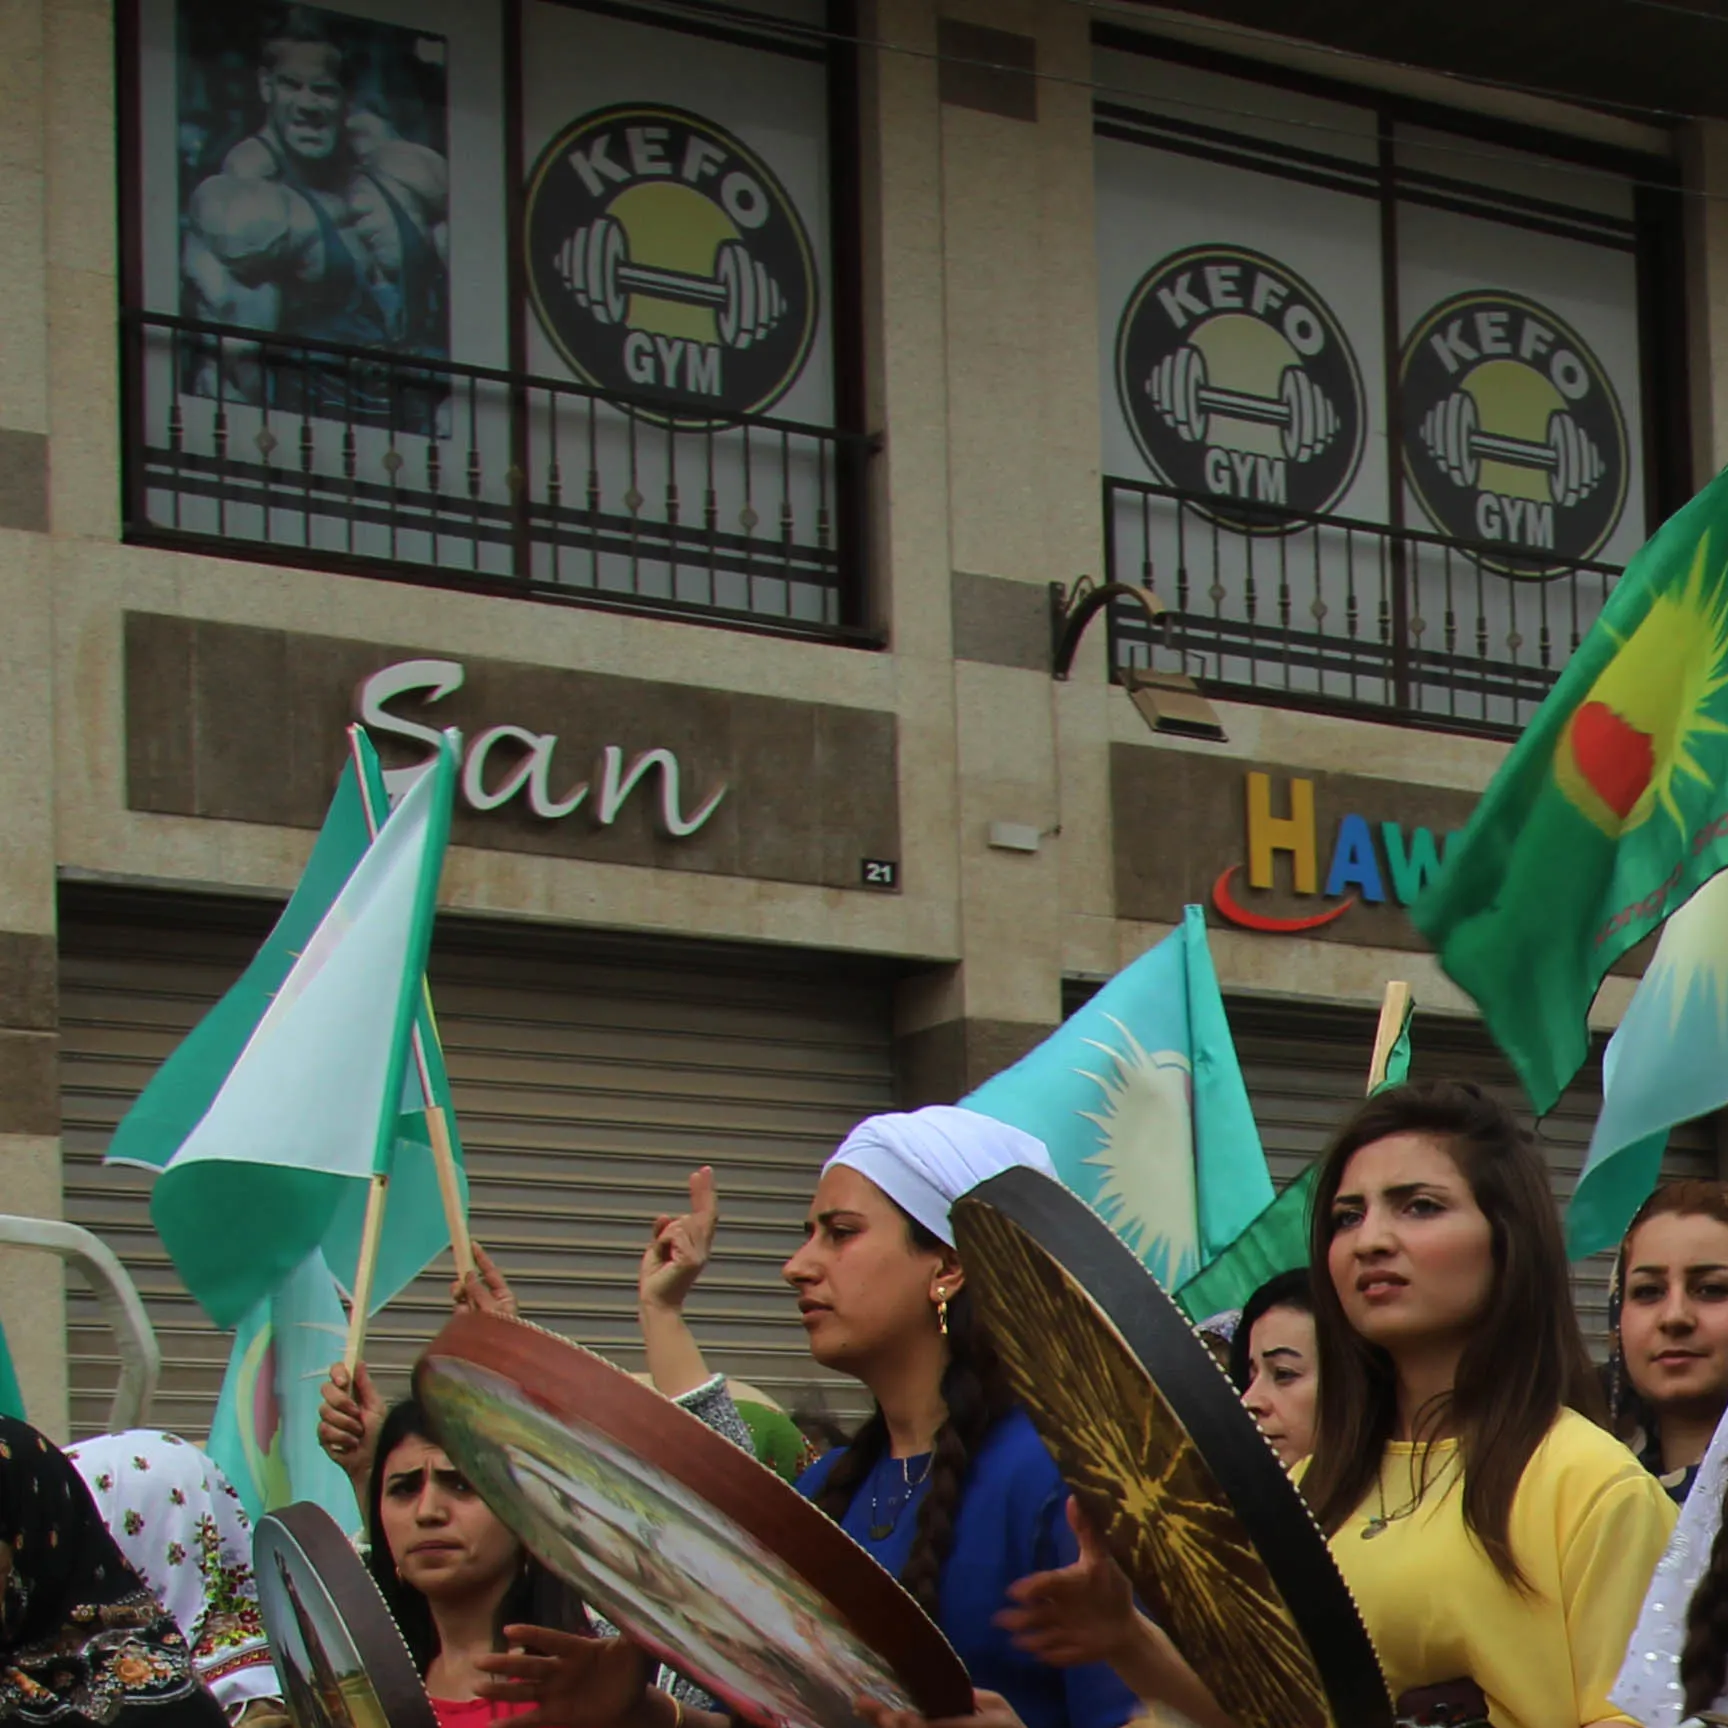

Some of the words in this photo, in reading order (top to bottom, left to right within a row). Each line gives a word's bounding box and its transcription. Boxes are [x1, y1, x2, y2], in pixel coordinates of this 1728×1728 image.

[569, 127, 770, 229] KEFO
[1156, 265, 1325, 356] KEFO
[623, 331, 723, 396] GYM
[1429, 311, 1591, 400] KEFO
[1204, 447, 1288, 505] GYM
[1475, 490, 1555, 549] GYM
[360, 659, 728, 837] San
[866, 863, 891, 882] 21
